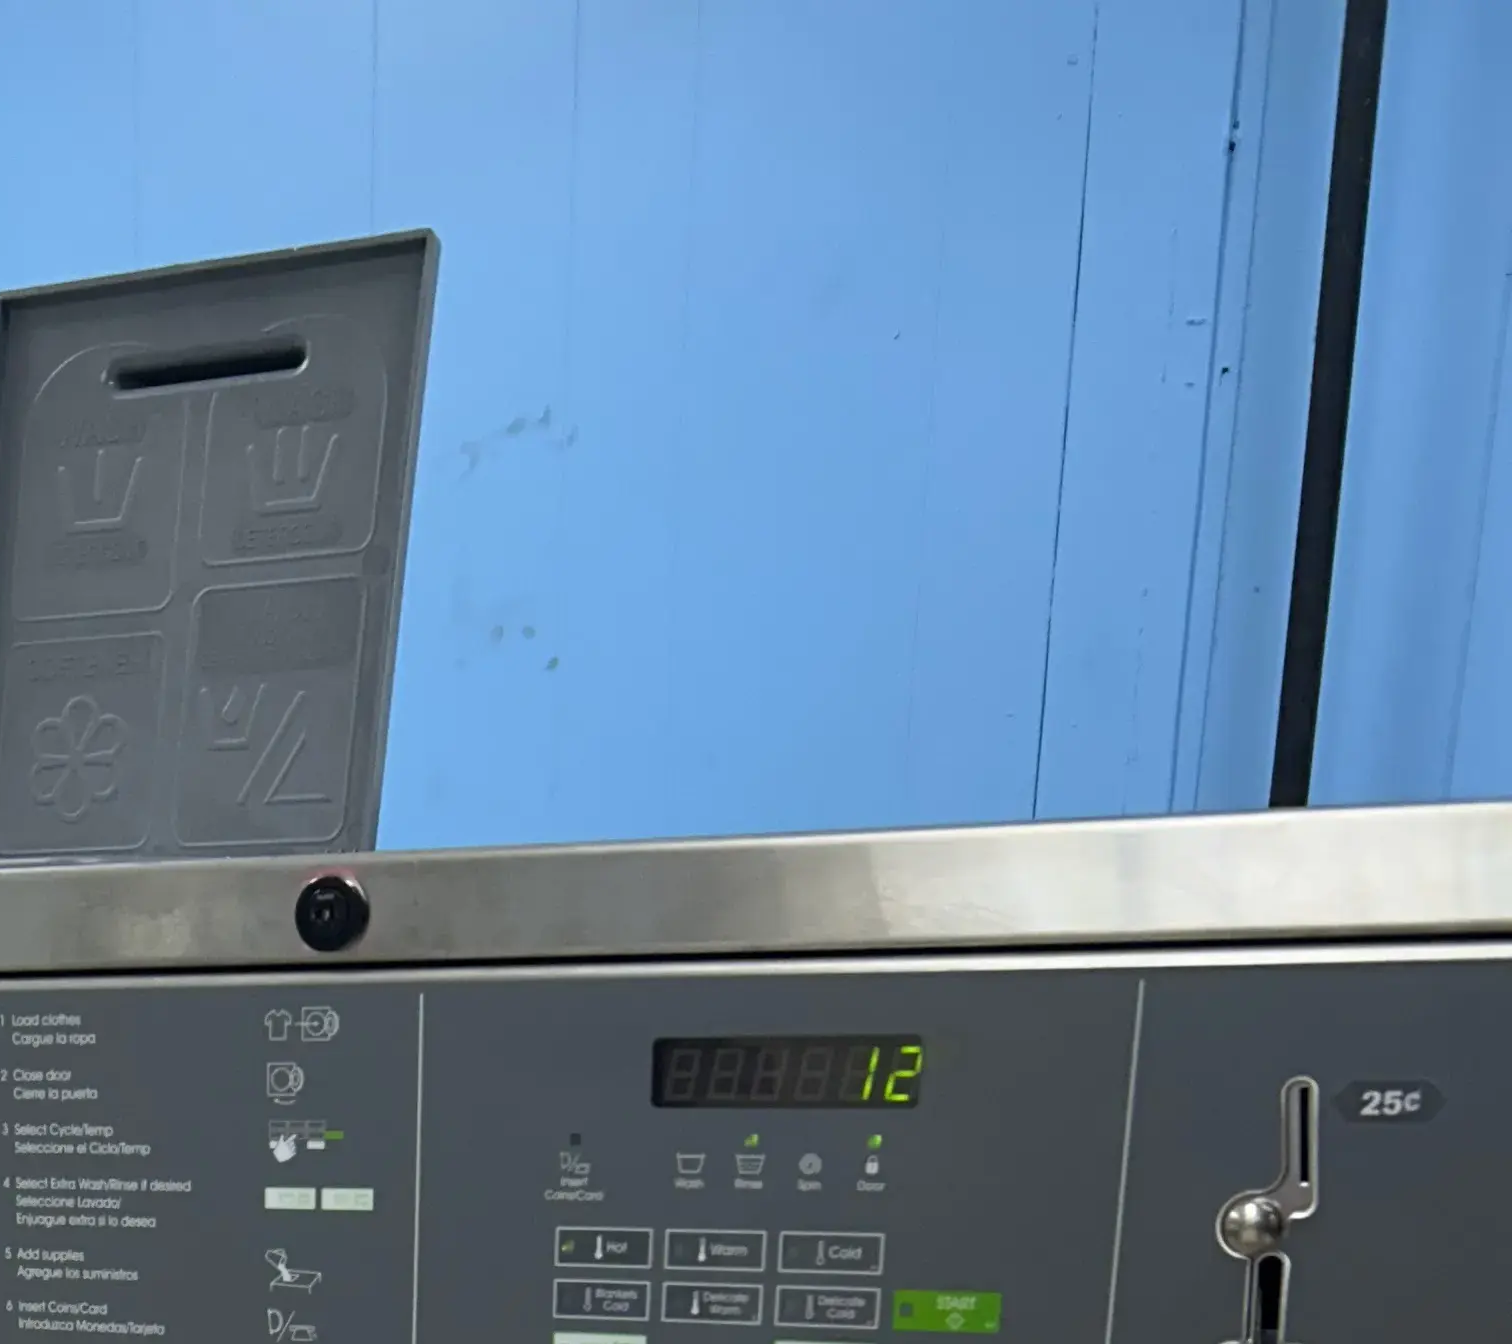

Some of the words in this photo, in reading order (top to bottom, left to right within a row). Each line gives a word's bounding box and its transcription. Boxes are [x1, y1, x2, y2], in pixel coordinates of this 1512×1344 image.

[0, 1014, 5, 1027] 1
[12, 1014, 39, 1027] Load
[41, 1013, 81, 1027] clothes
[12, 1032, 54, 1048] Cargue
[56, 1033, 66, 1045] la
[70, 1033, 96, 1046] ropa
[0, 1069, 8, 1082] 2
[13, 1068, 43, 1082] Close
[46, 1069, 72, 1082] door
[860, 1045, 924, 1103] 12
[48, 1087, 59, 1100] la
[61, 1088, 98, 1101] puerta
[2, 1121, 9, 1136] 3
[14, 1122, 47, 1137] Select
[49, 1123, 114, 1138] Cycle/Temp
[14, 1141, 74, 1155] Seleccione
[76, 1142, 87, 1154] el
[89, 1142, 151, 1157] Ciclo/Temp
[3, 1176, 11, 1189] 4
[15, 1176, 48, 1190] Select
[50, 1177, 76, 1190] Extra
[78, 1177, 138, 1191] Wash/Rinse
[149, 1179, 192, 1192] desired
[15, 1194, 75, 1208] Seleccione
[15, 1212, 67, 1229] Enjuague
[69, 1213, 96, 1227] extra
[108, 1214, 119, 1227] lo
[120, 1215, 156, 1228] desea
[5, 1246, 12, 1260] 5
[17, 1247, 40, 1261] Add
[42, 1249, 85, 1263] supplies
[828, 1246, 863, 1260] Cold
[17, 1265, 63, 1281] Agregue
[65, 1267, 80, 1280] los
[83, 1268, 139, 1282] suministros
[6, 1300, 14, 1312] 6
[18, 1300, 46, 1313] Insert
[47, 1300, 108, 1316] Coins/Card
[18, 1317, 74, 1332] Introduzca
[76, 1319, 166, 1336] Monedas/Tarjeta
